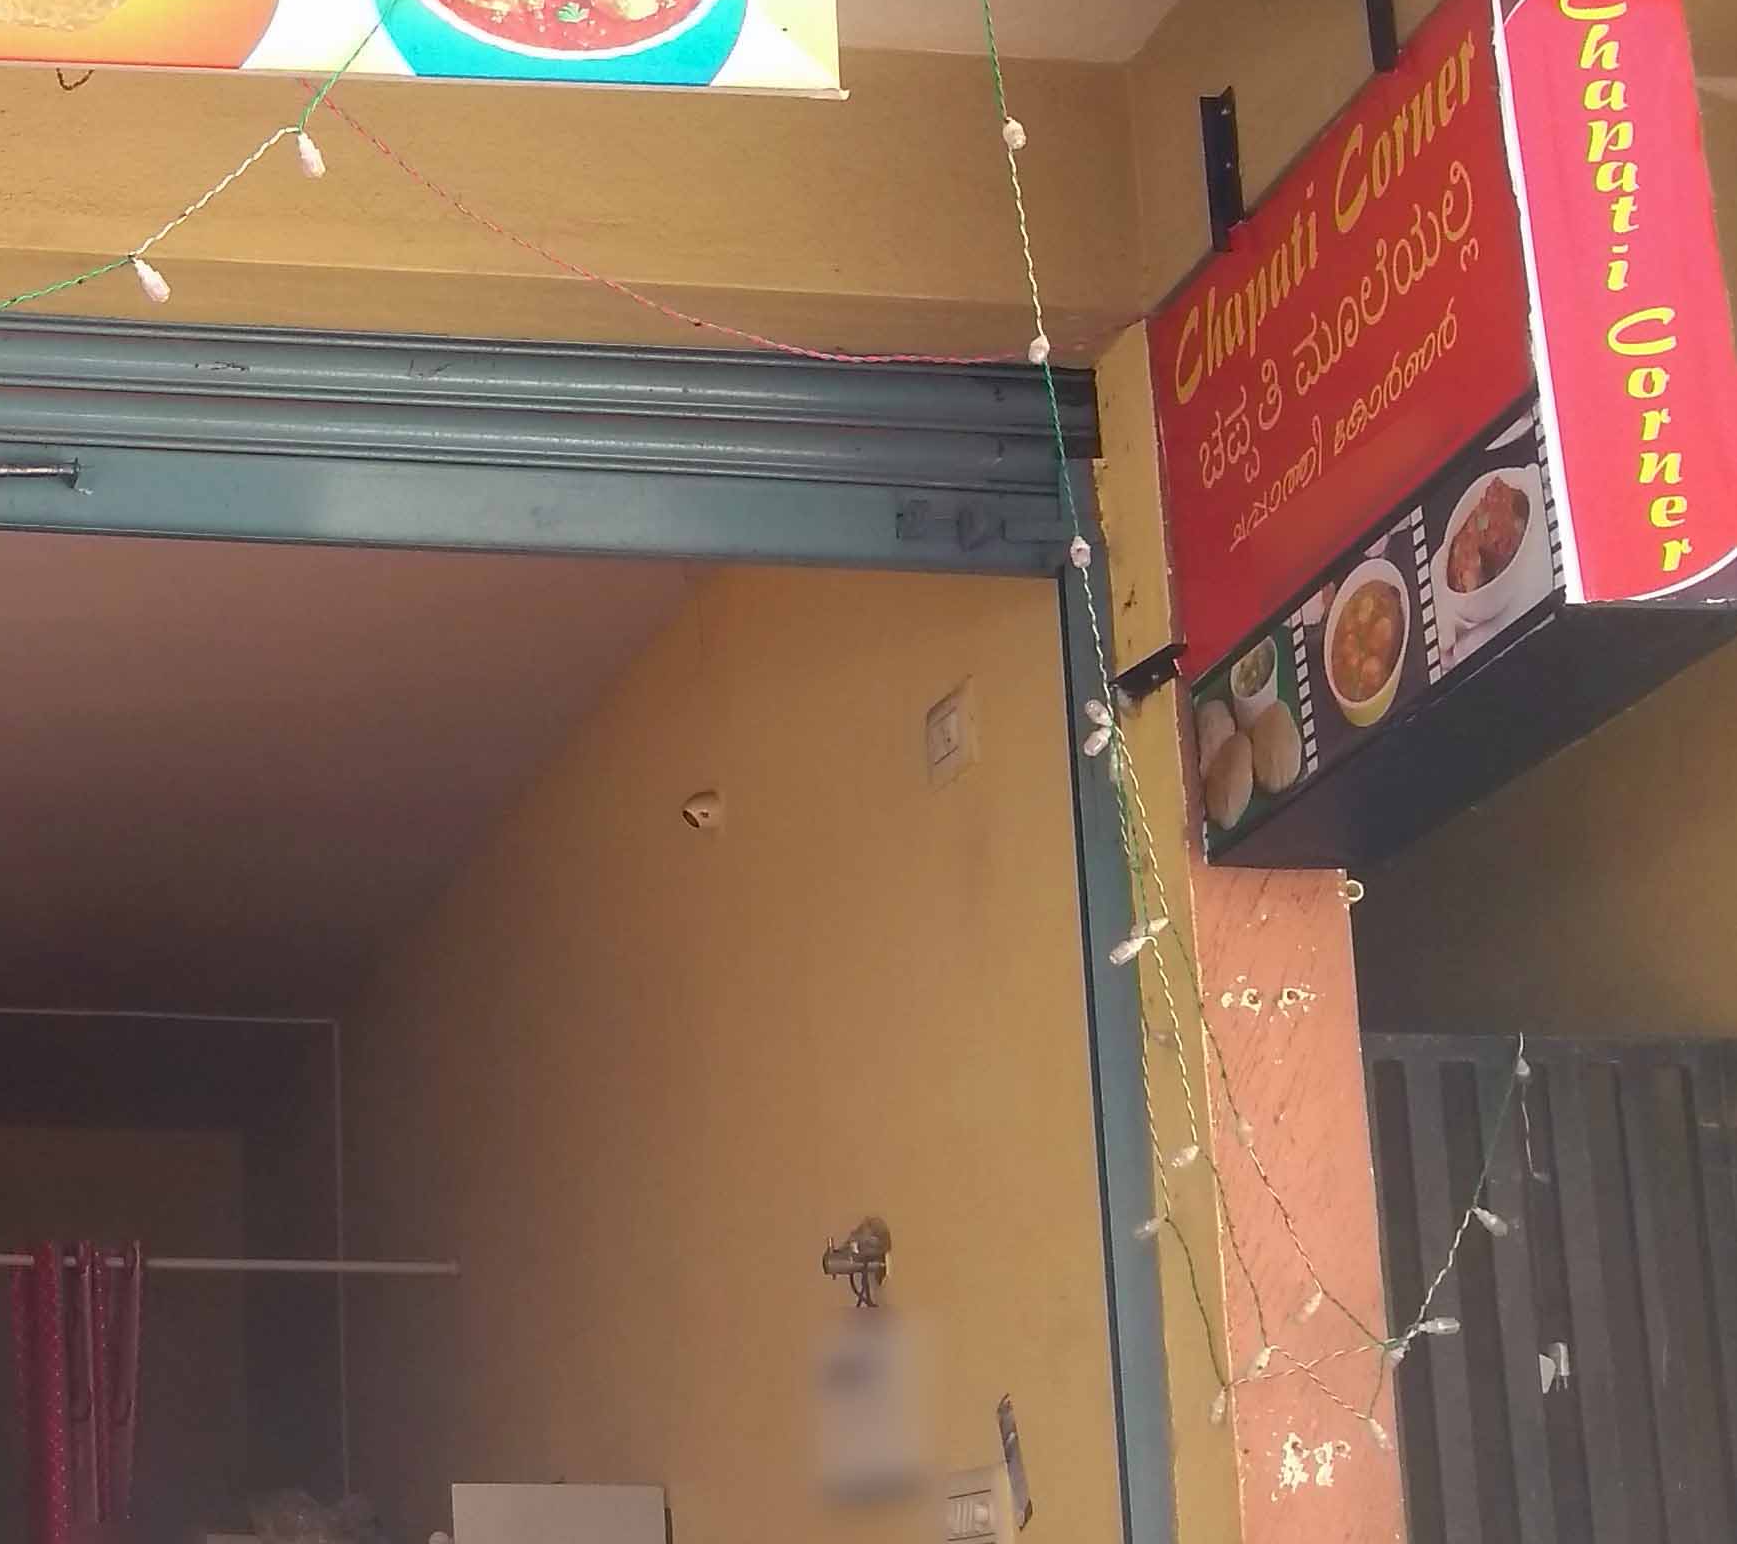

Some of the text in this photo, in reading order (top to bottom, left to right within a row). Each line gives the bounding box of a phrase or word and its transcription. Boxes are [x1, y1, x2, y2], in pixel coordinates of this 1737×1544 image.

[1175, 29, 1477, 406] Chapati Corner
[1292, 160, 1481, 397] ಮೂಲೆಯಲ್ಲಿ
[1229, 296, 1459, 552] ചപ്പാത്തി കോർണർ
[1606, 306, 1693, 573] Corner
